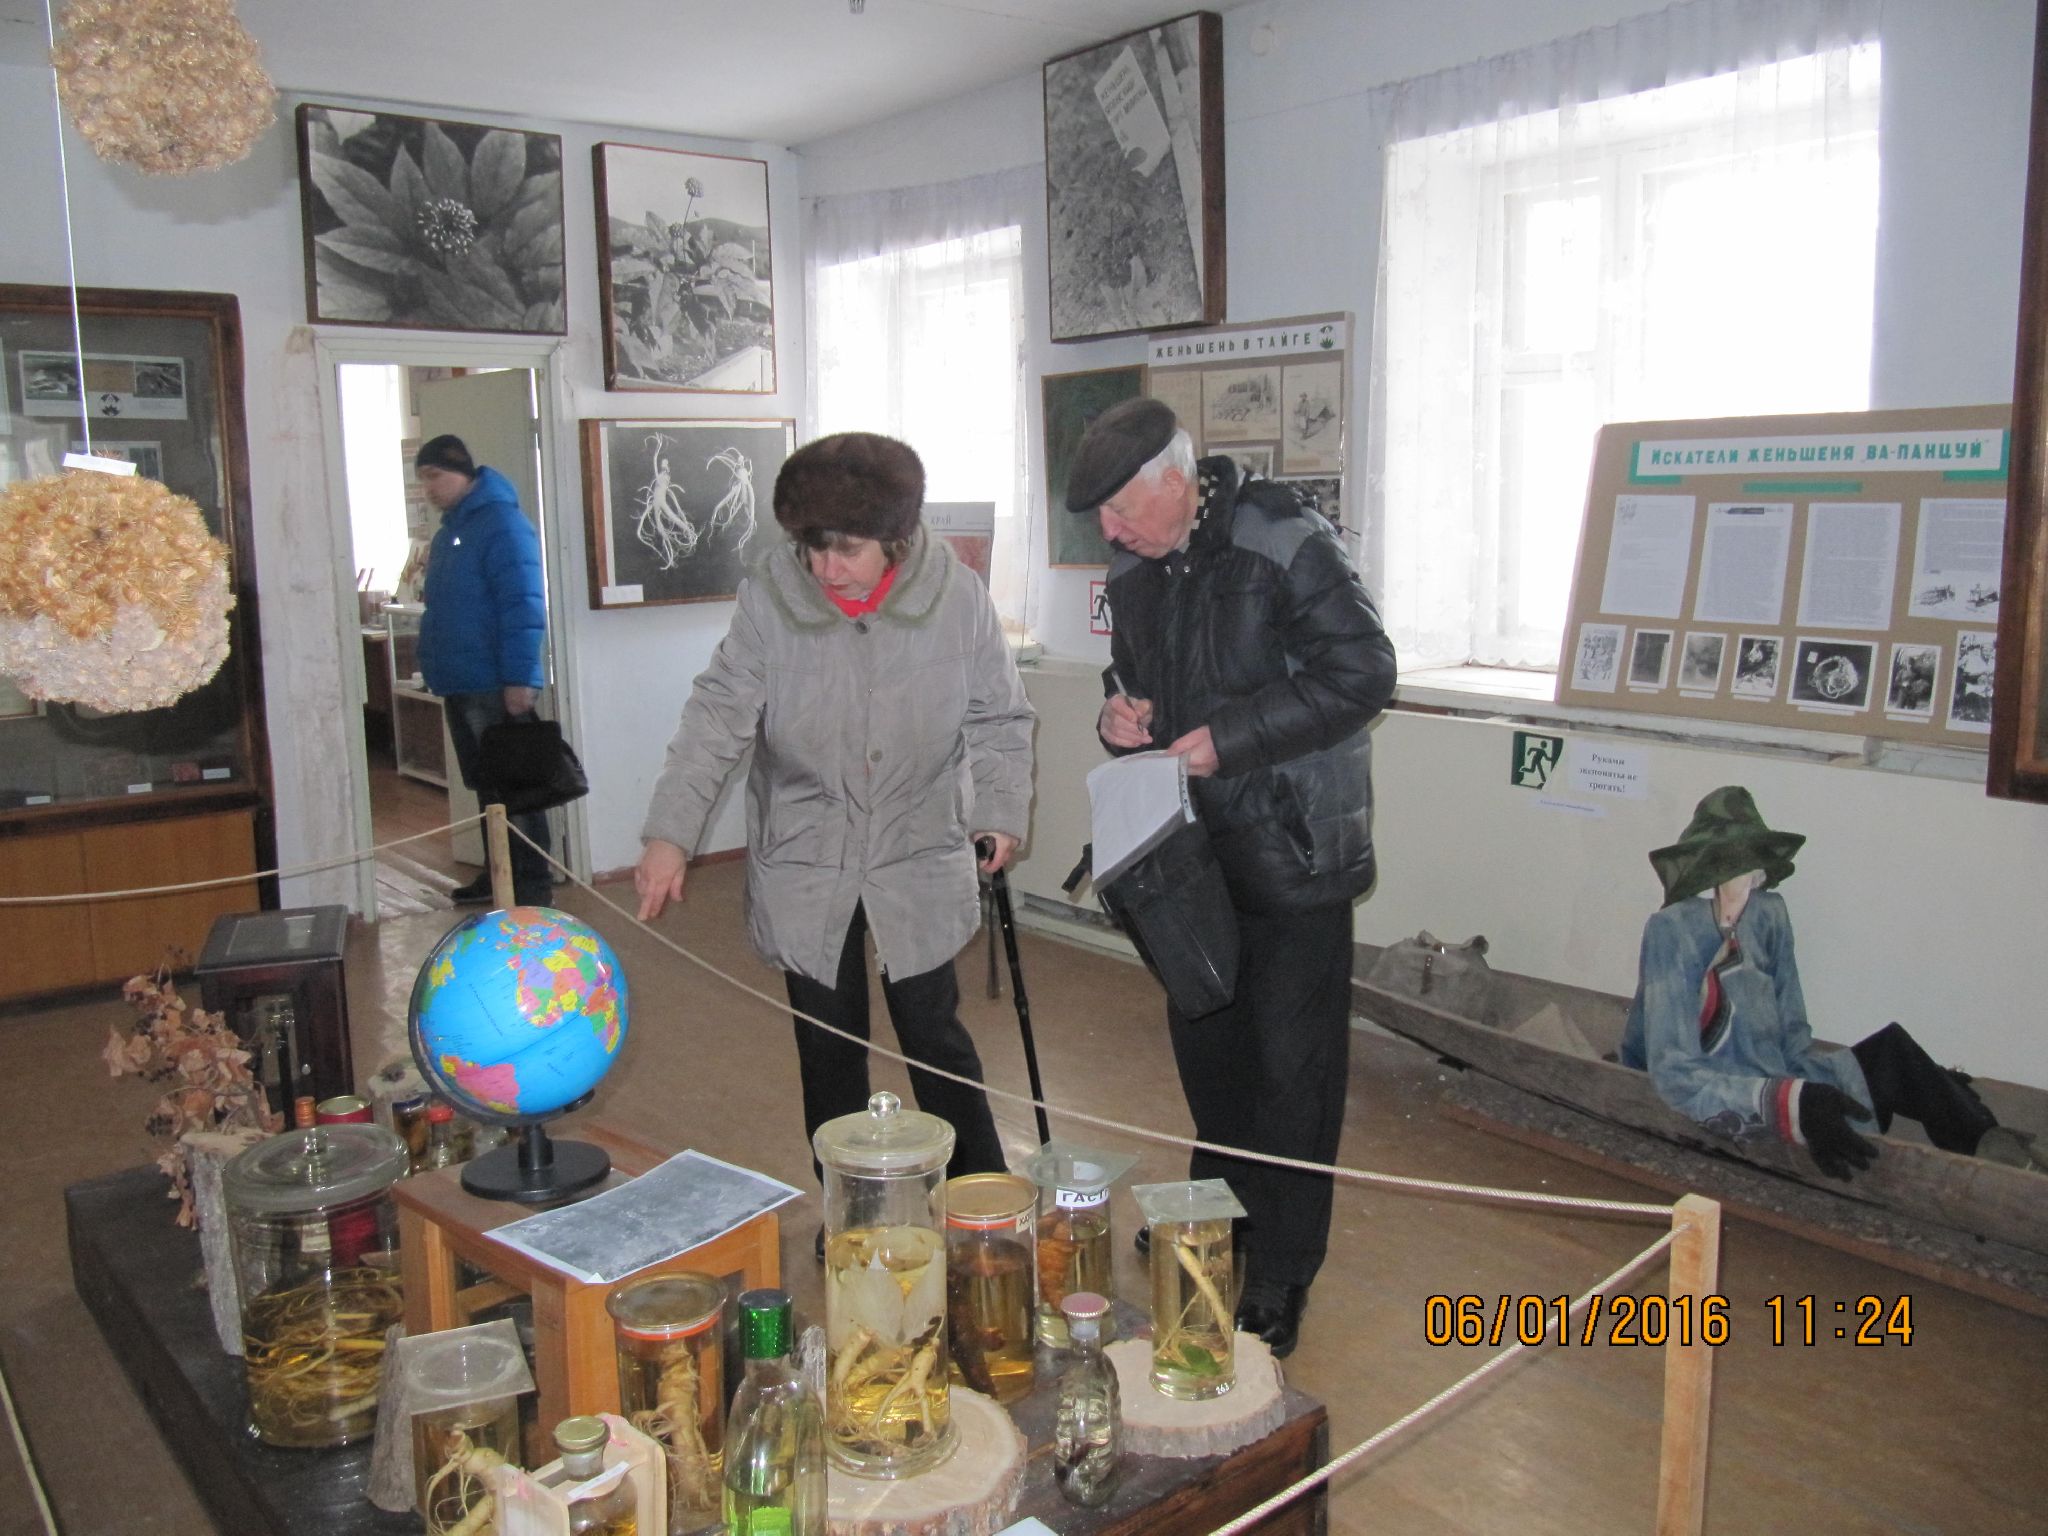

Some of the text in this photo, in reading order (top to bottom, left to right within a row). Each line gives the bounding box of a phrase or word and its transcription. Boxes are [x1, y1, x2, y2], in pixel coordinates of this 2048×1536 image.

[1156, 331, 1311, 358] ЖЕНЬШЕНЬ В ТАЙГЕ
[1747, 445, 1855, 463] ЖЕНЬШЕНЯ
